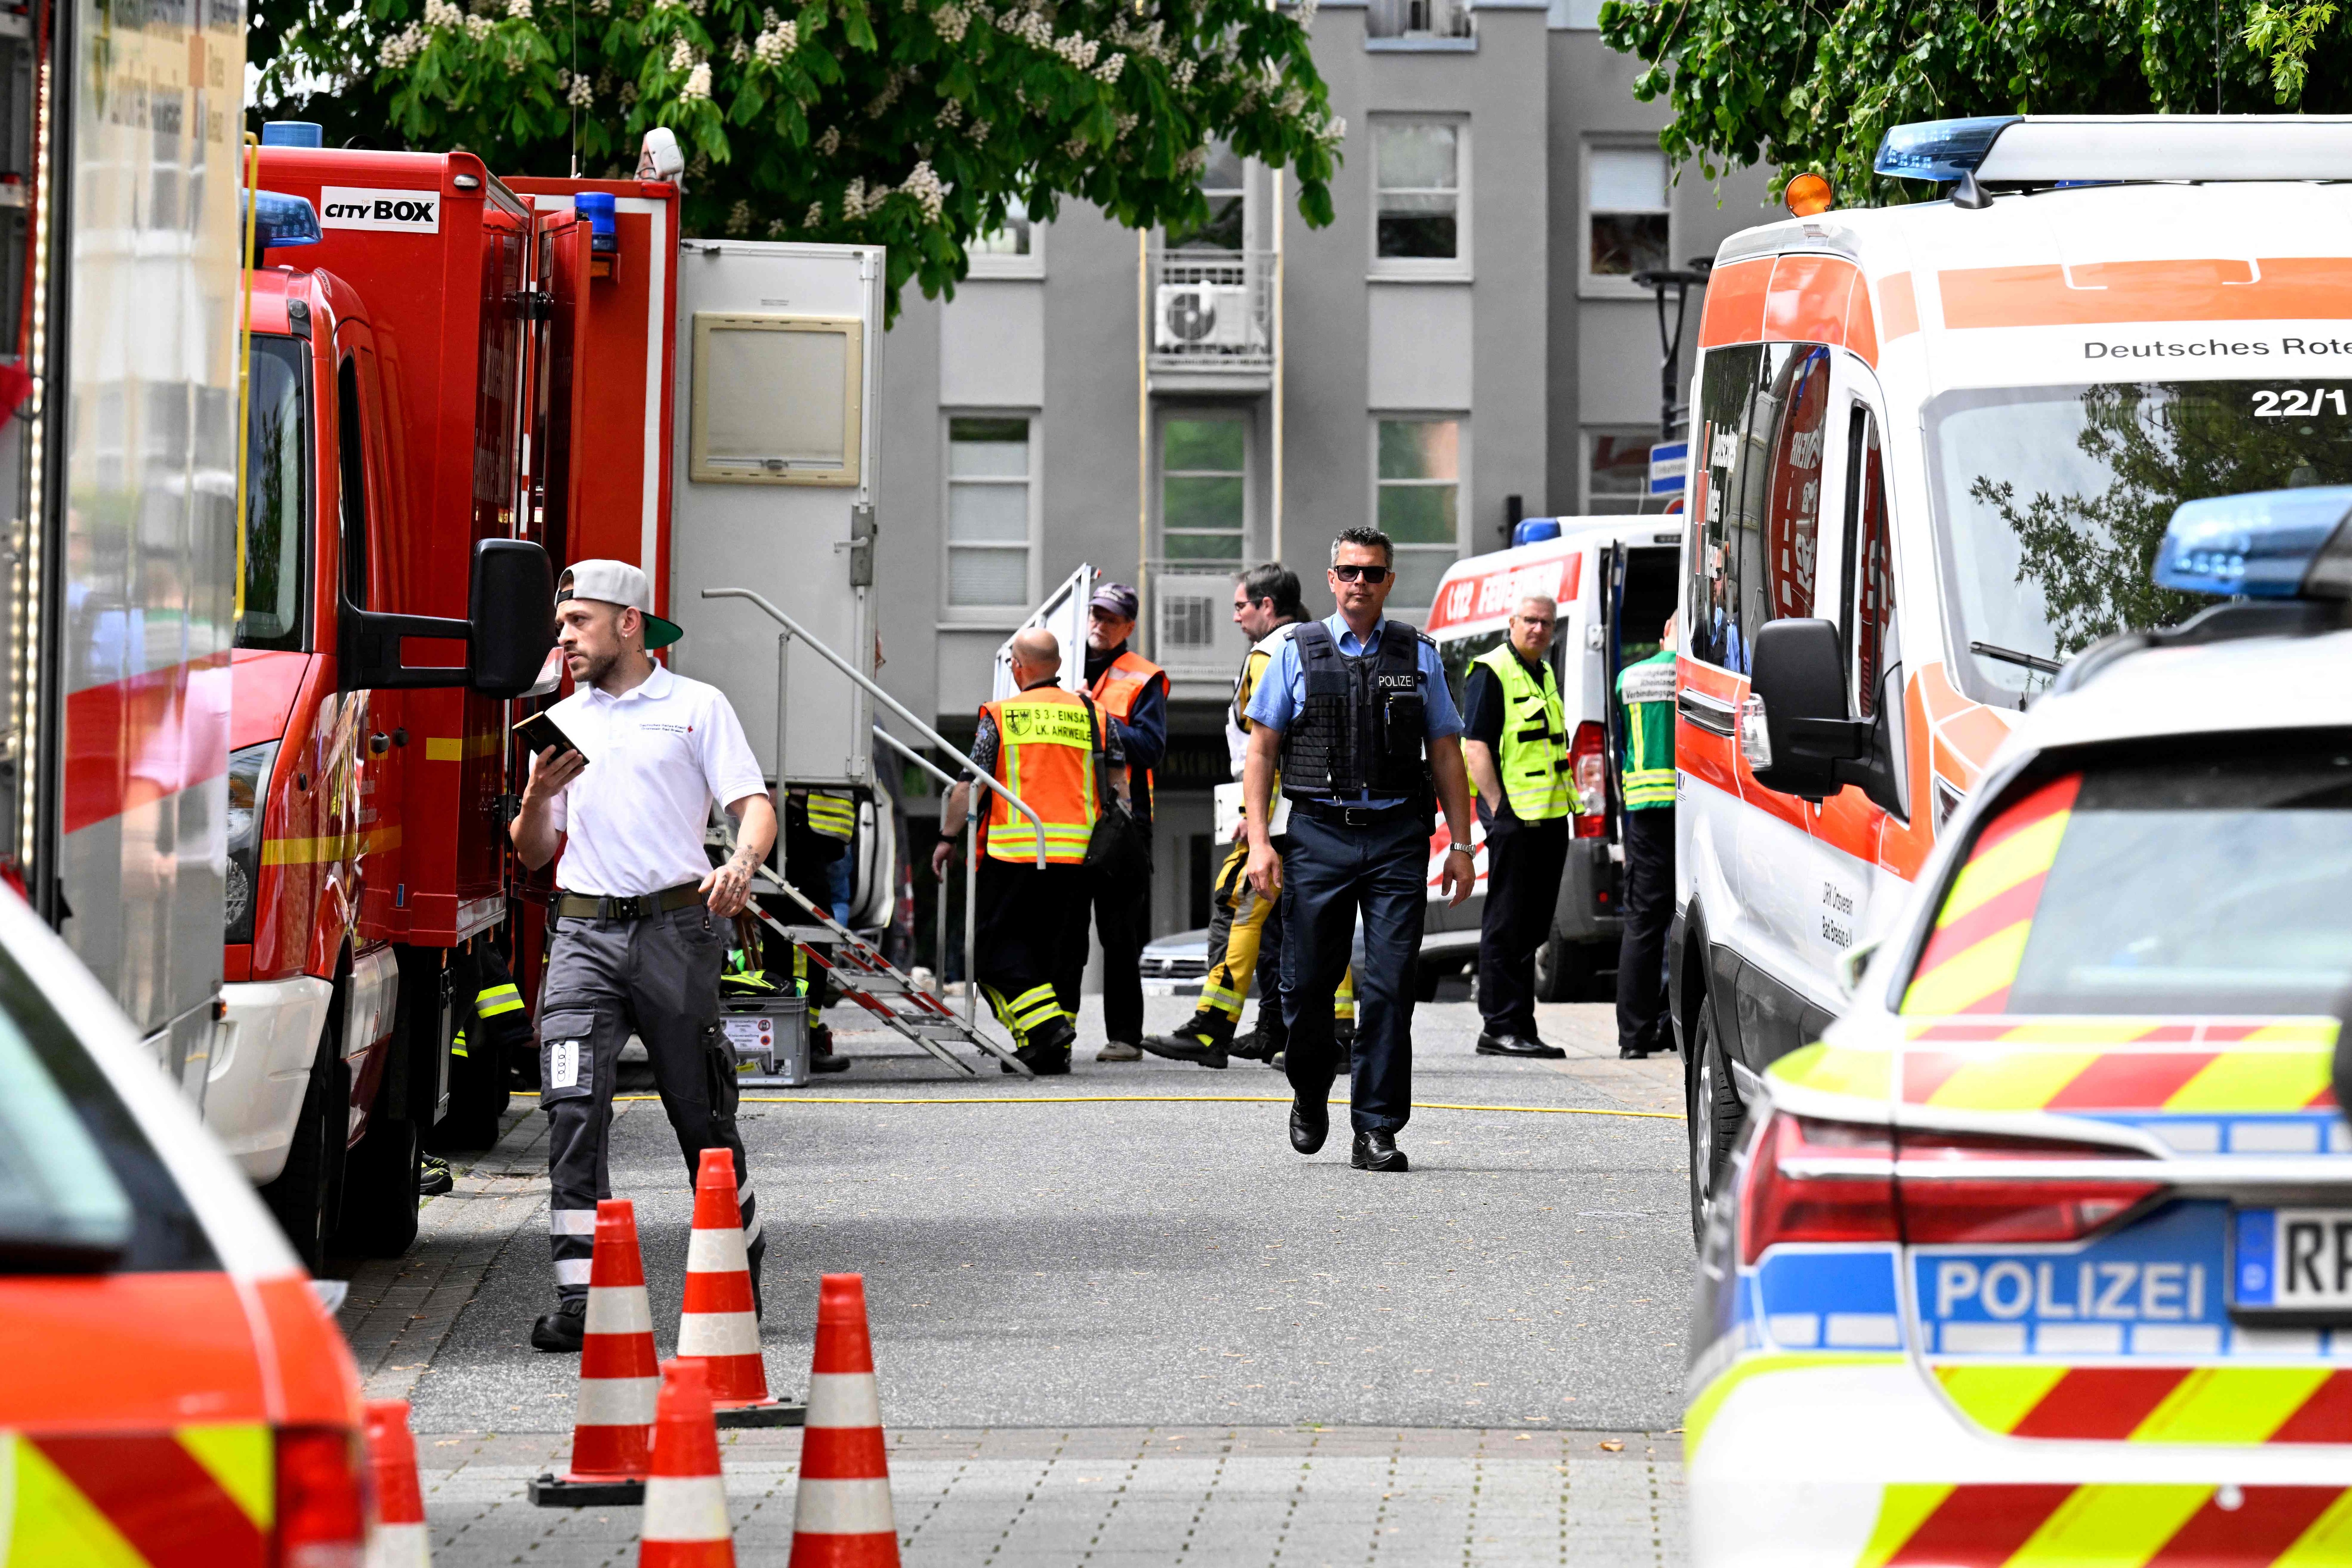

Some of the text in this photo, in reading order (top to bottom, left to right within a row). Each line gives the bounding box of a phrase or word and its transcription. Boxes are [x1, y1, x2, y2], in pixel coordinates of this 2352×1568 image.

[325, 200, 434, 222] CITY BOX
[2084, 339, 2270, 359] Deutsches
[2252, 389, 2347, 416] 22/1
[1711, 422, 1738, 470] Deutsches
[1707, 477, 1720, 523] Rotes
[1379, 676, 1414, 687] POLIZEI
[1035, 709, 1040, 719] S
[1044, 709, 1049, 719] 3
[1036, 725, 1049, 735] LK.
[1833, 886, 1853, 916] Ortsverein
[1831, 919, 1846, 952] Breisig
[1936, 1261, 2206, 1320] POLIZEI
